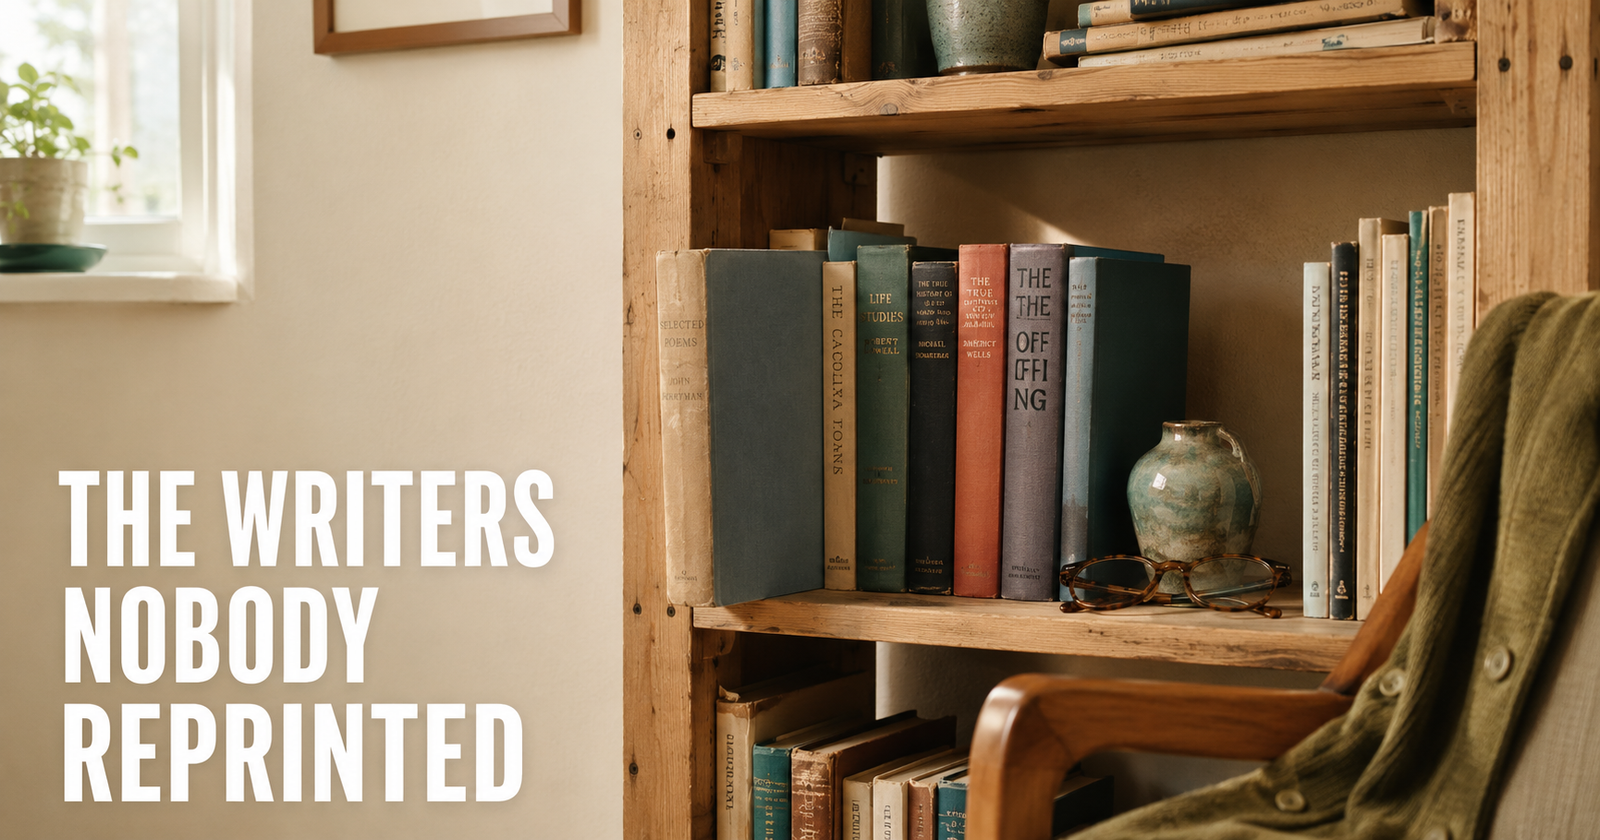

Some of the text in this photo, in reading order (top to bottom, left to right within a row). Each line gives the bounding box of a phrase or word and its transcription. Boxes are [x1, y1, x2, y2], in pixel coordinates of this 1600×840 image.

[970, 276, 991, 286] THE
[1016, 267, 1052, 289] THE
[869, 293, 892, 304] LIFE
[966, 288, 994, 298] TRUE
[831, 284, 843, 319] THE
[1015, 295, 1051, 317] THE
[860, 311, 904, 323] STUDIES
[660, 319, 705, 330] SELECTED
[664, 337, 698, 348] POEMS
[1016, 331, 1050, 353] OFF
[966, 351, 991, 359] WELLS
[668, 377, 690, 386] JOHN
[1013, 388, 1047, 411] NG
